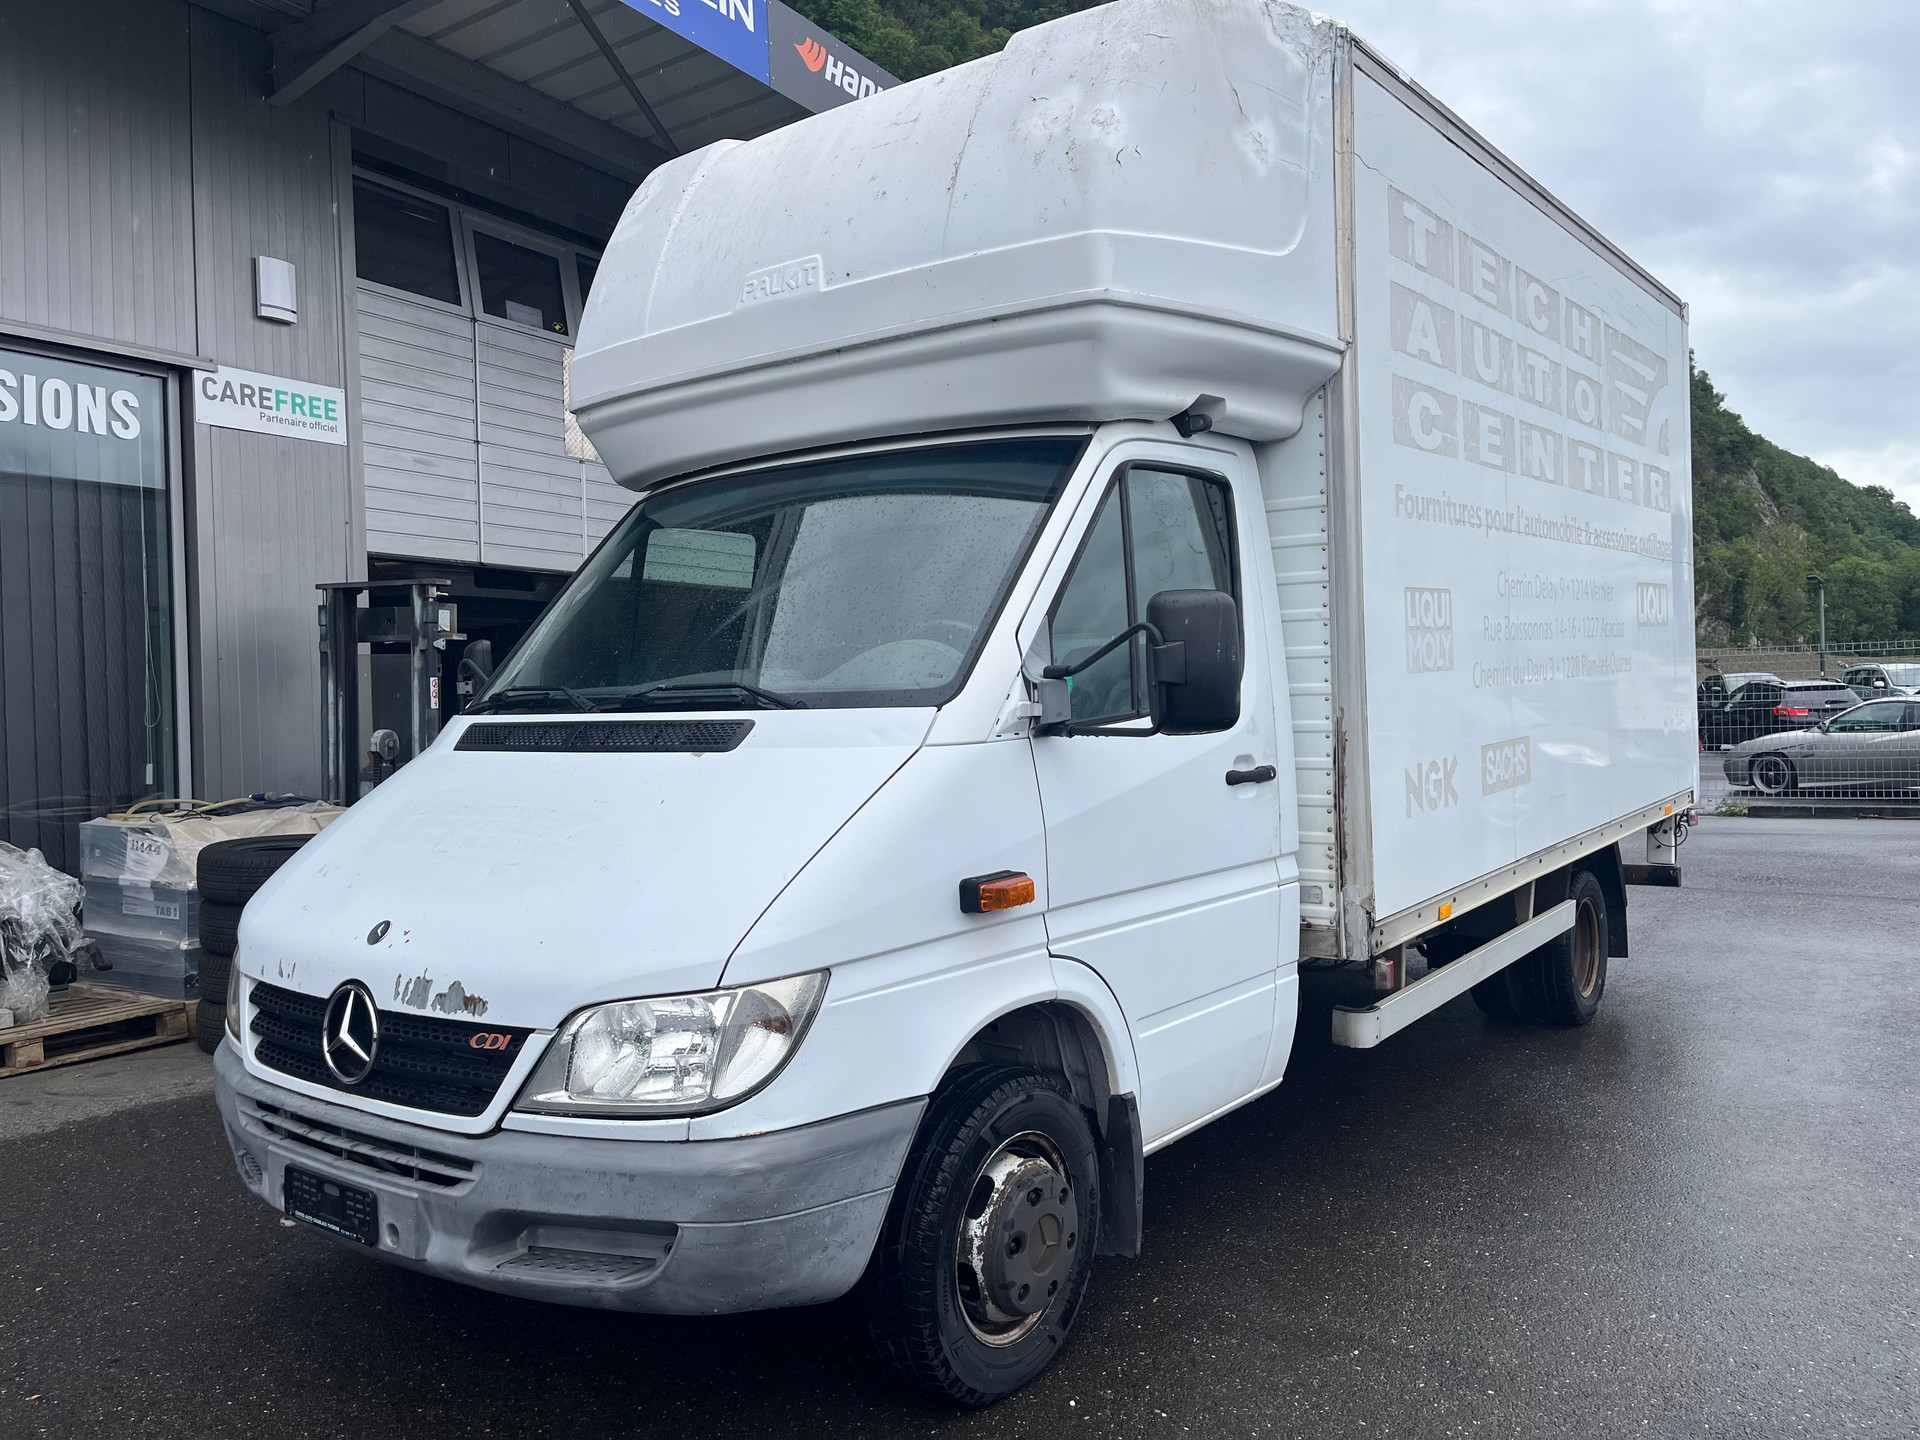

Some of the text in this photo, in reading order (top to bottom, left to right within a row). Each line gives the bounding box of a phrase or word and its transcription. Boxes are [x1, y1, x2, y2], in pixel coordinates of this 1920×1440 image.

[825, 54, 884, 100] Han
[1403, 200, 1594, 359] TECH
[1405, 300, 1596, 425] AUTO
[202, 376, 338, 422] CAREFREE
[259, 411, 339, 434] Partenaire officiel
[1408, 391, 1666, 510] CENTER
[1394, 483, 1482, 530] Fournitures
[1486, 507, 1515, 539] pour
[1594, 527, 1638, 552] accessoires
[1497, 571, 1533, 598] Chemin
[1535, 574, 1558, 606] Delay
[1559, 577, 1565, 600] 9
[1571, 578, 1590, 600] 1214
[1637, 585, 1668, 625] LIQUI
[1406, 590, 1451, 629] LIQUI
[1483, 615, 1502, 641] Rue
[1504, 615, 1553, 641] Boissonnas
[1407, 632, 1453, 671] MOLY
[1472, 660, 1511, 688] Chemin
[1513, 656, 1525, 684] du
[1486, 742, 1527, 785] SACHS
[1404, 754, 1459, 818] NGK
[154, 905, 172, 917] TAB
[469, 1032, 513, 1051] CDI
